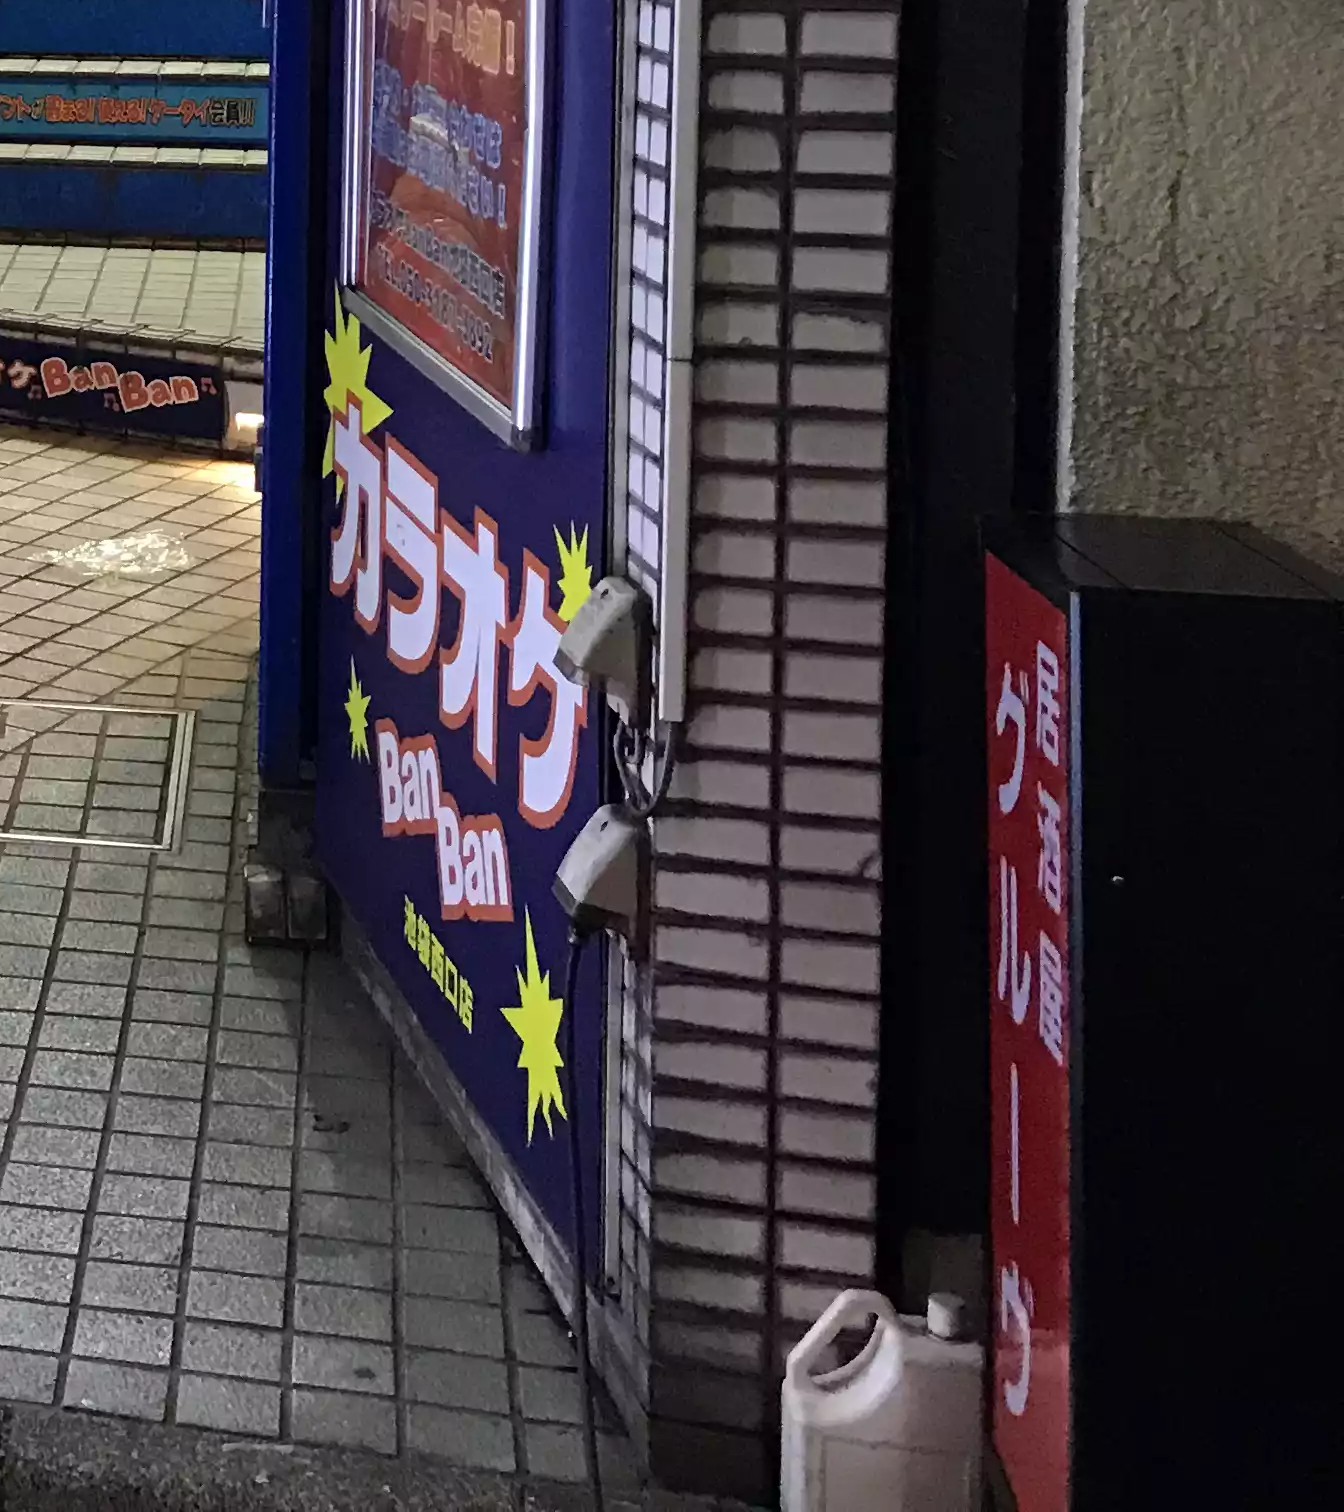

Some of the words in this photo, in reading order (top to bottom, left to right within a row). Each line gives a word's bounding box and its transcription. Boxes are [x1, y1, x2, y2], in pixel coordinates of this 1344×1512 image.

[330, 392, 588, 829] カラオケ
[375, 718, 440, 838] Ban
[437, 793, 513, 922] Ban
